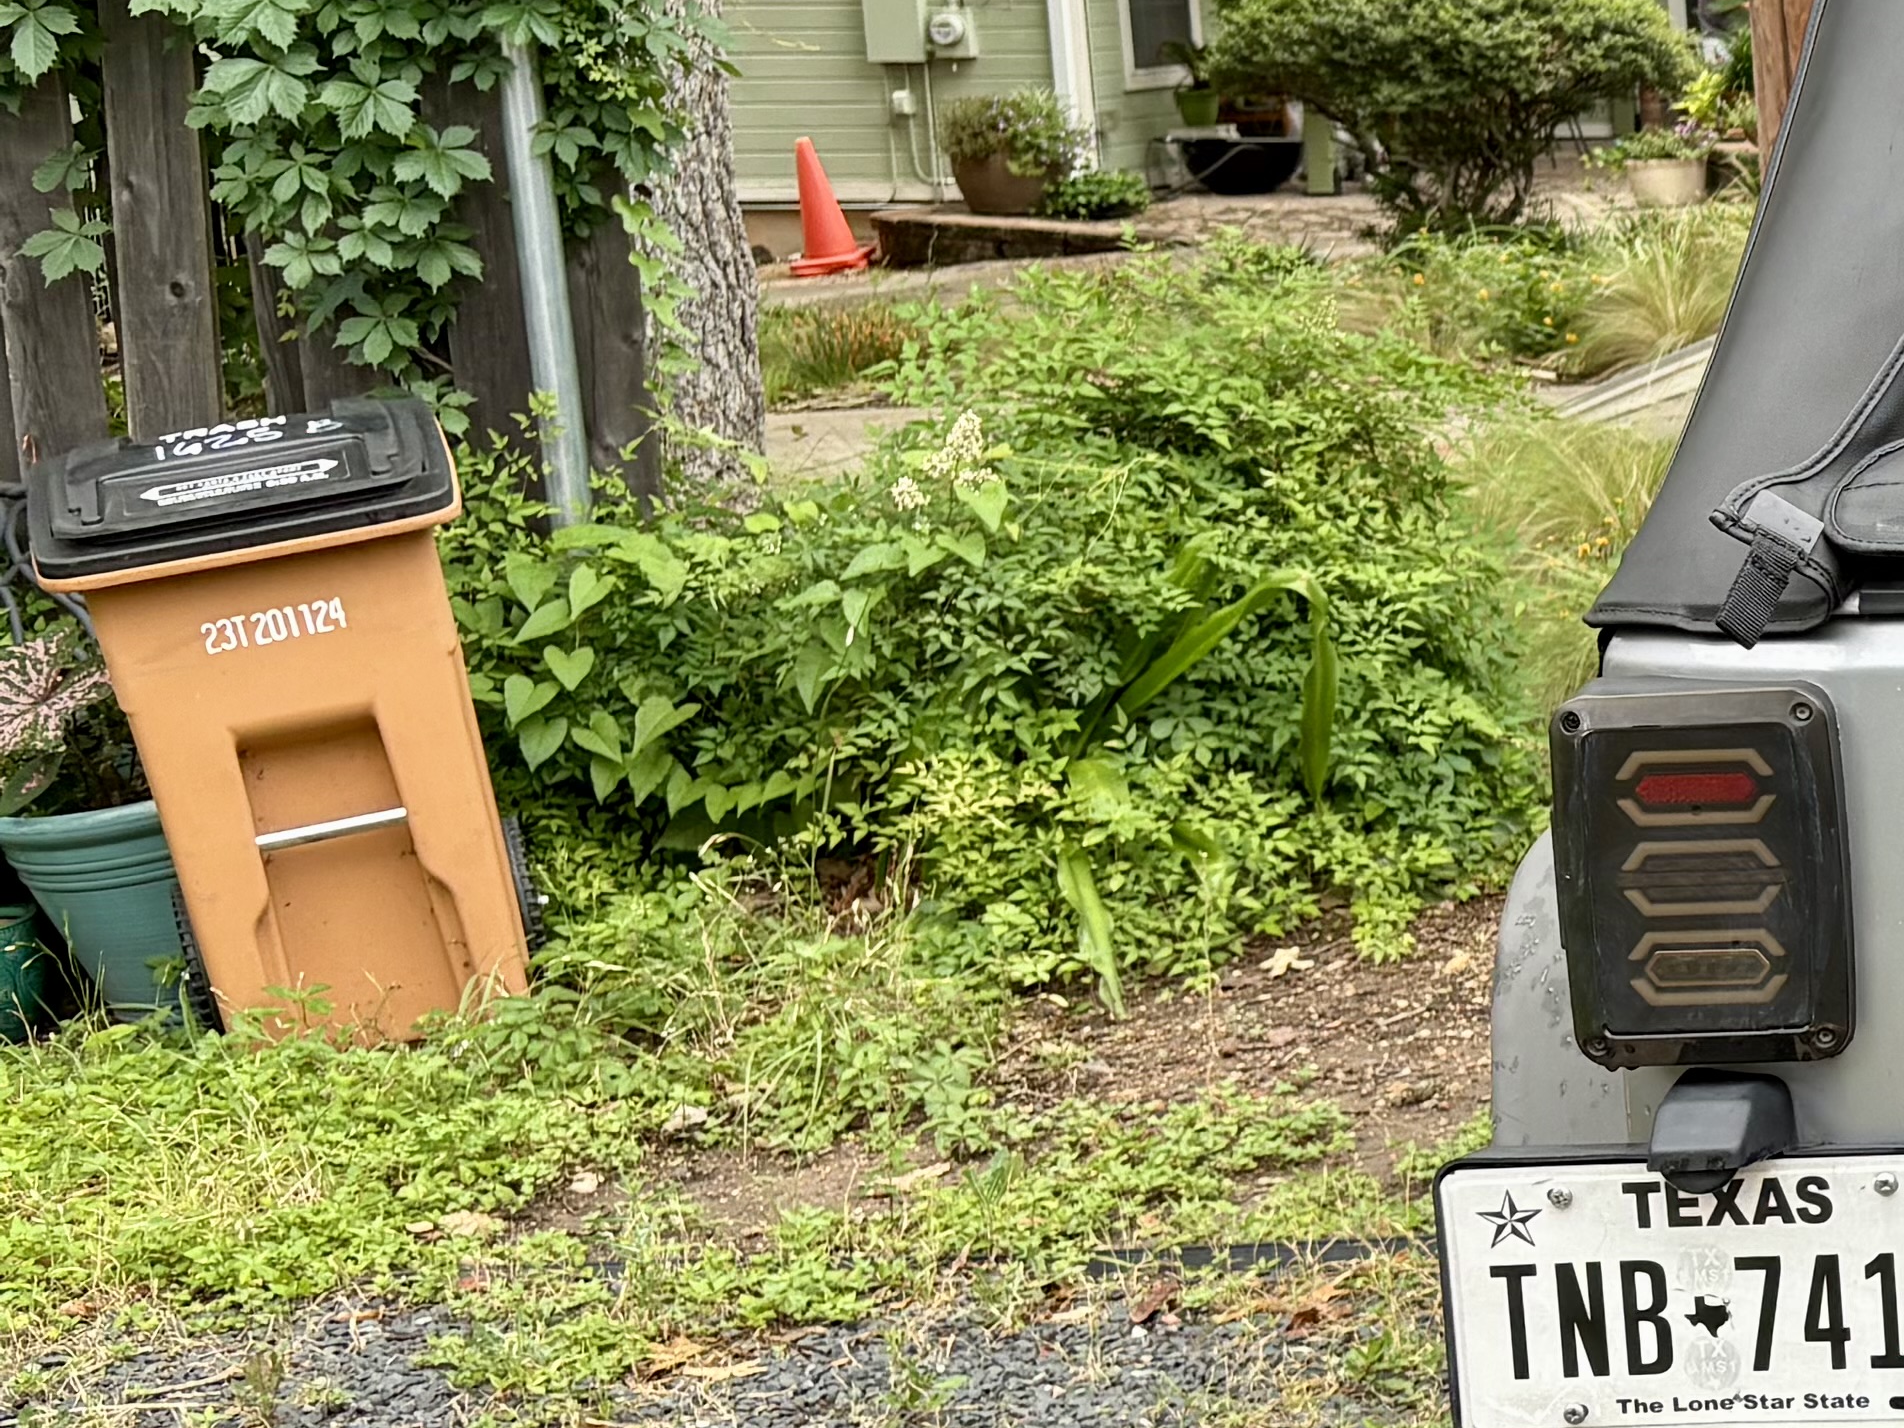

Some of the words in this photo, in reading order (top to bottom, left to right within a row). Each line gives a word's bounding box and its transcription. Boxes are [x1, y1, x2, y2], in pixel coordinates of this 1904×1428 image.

[1622, 1175, 1834, 1230] TEXAS
[1490, 1259, 1674, 1380] TNB
[1616, 1398, 1664, 1415] The
[1672, 1396, 1735, 1413] Lone
[1742, 1393, 1796, 1411] Star
[1803, 1392, 1870, 1410] State
